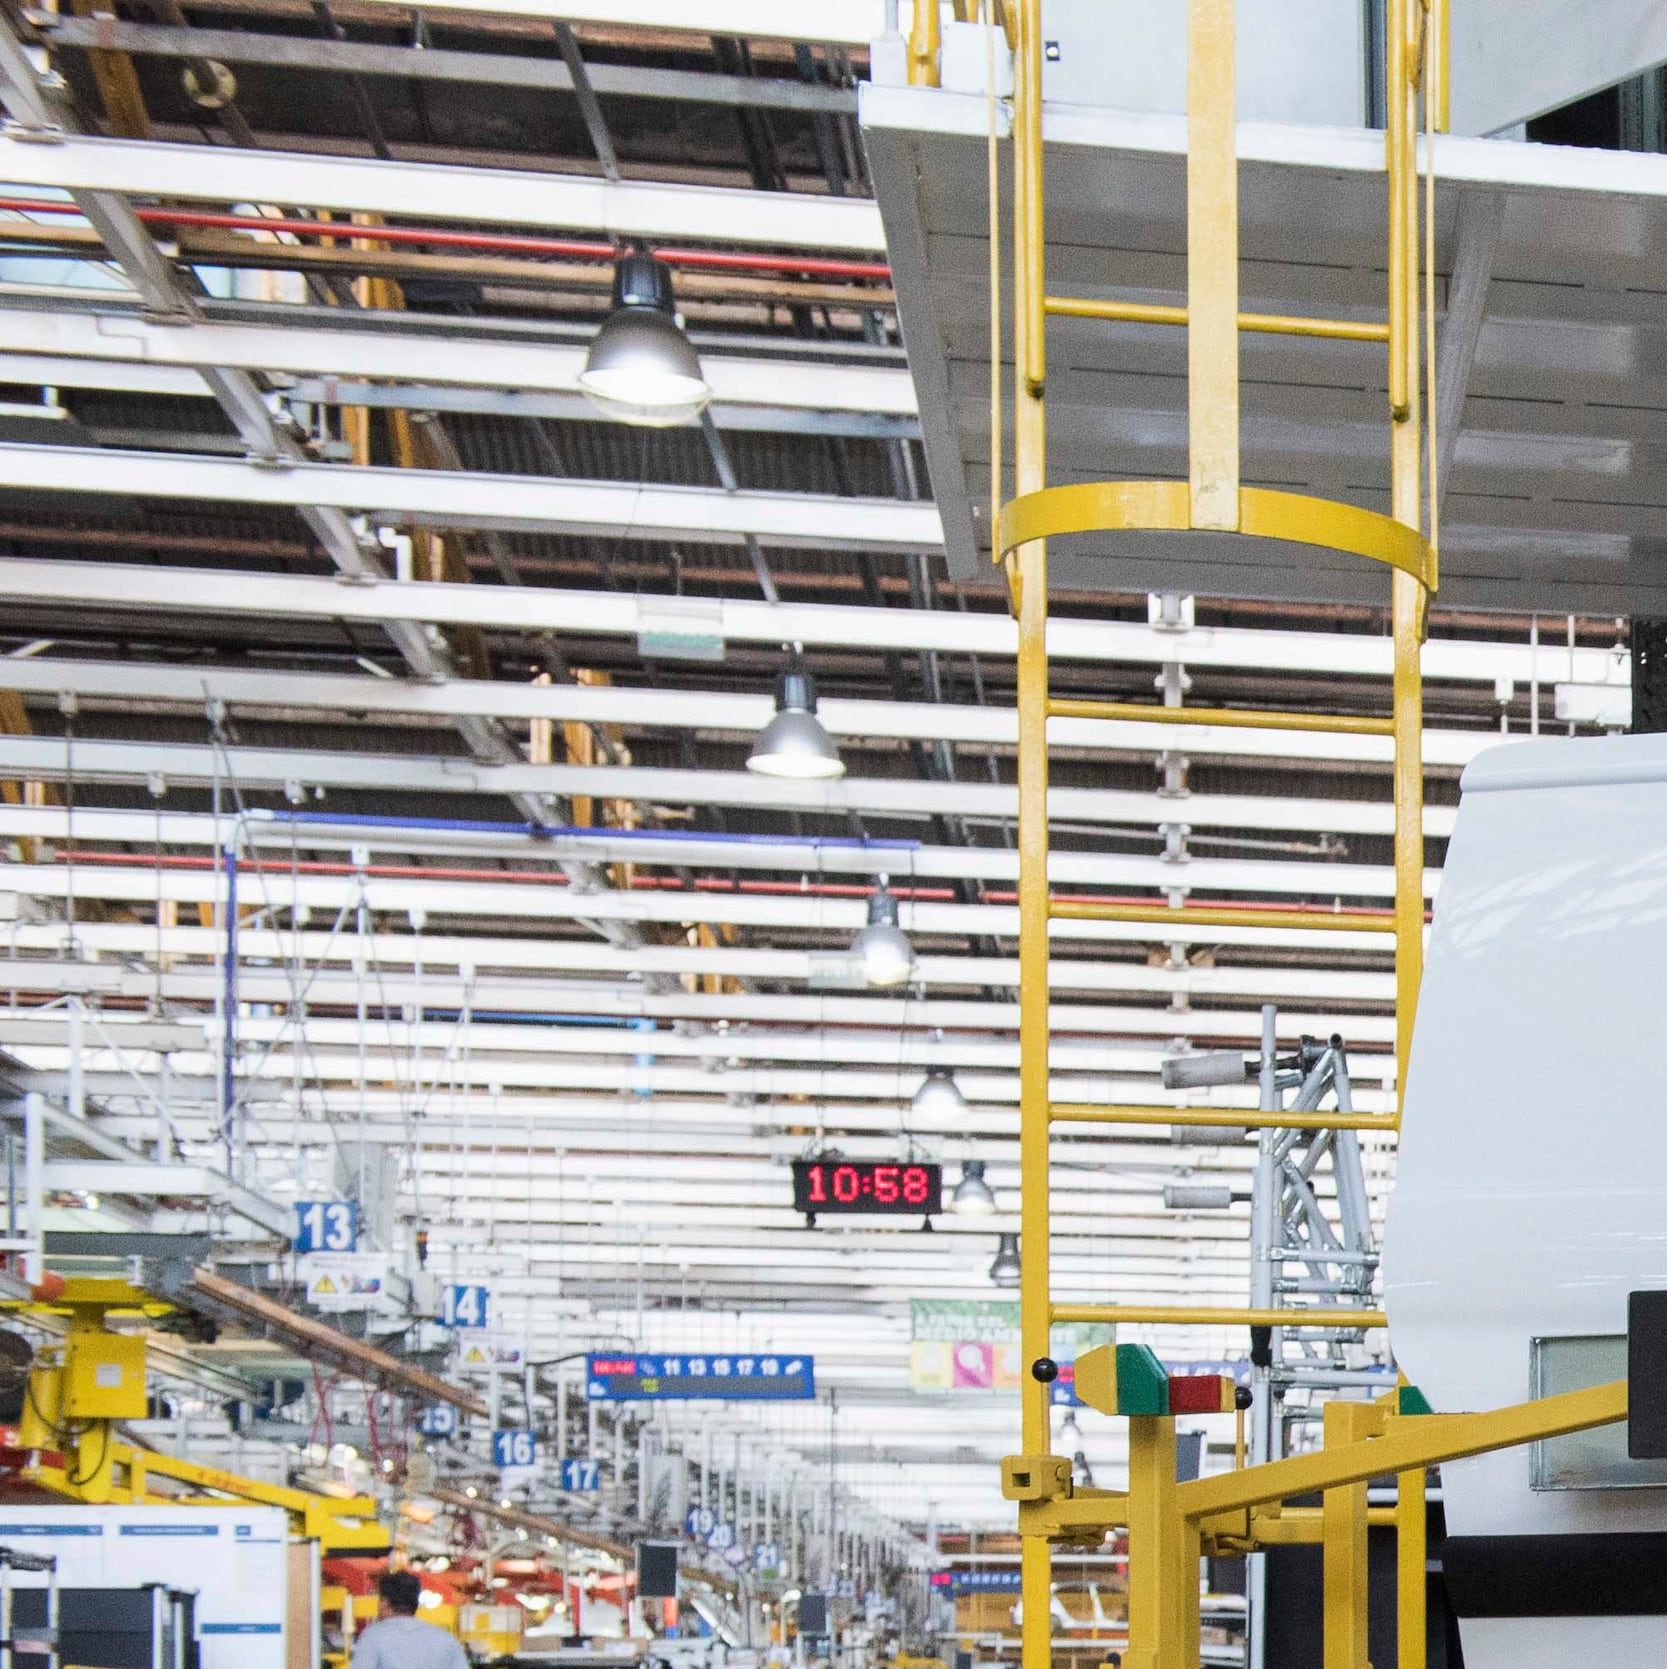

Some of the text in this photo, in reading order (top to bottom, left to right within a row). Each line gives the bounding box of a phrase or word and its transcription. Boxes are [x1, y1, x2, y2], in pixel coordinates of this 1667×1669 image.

[809, 1165, 929, 1203] 10:58
[304, 1203, 350, 1250] 13
[499, 1431, 531, 1464] 16
[567, 1461, 598, 1490] 17
